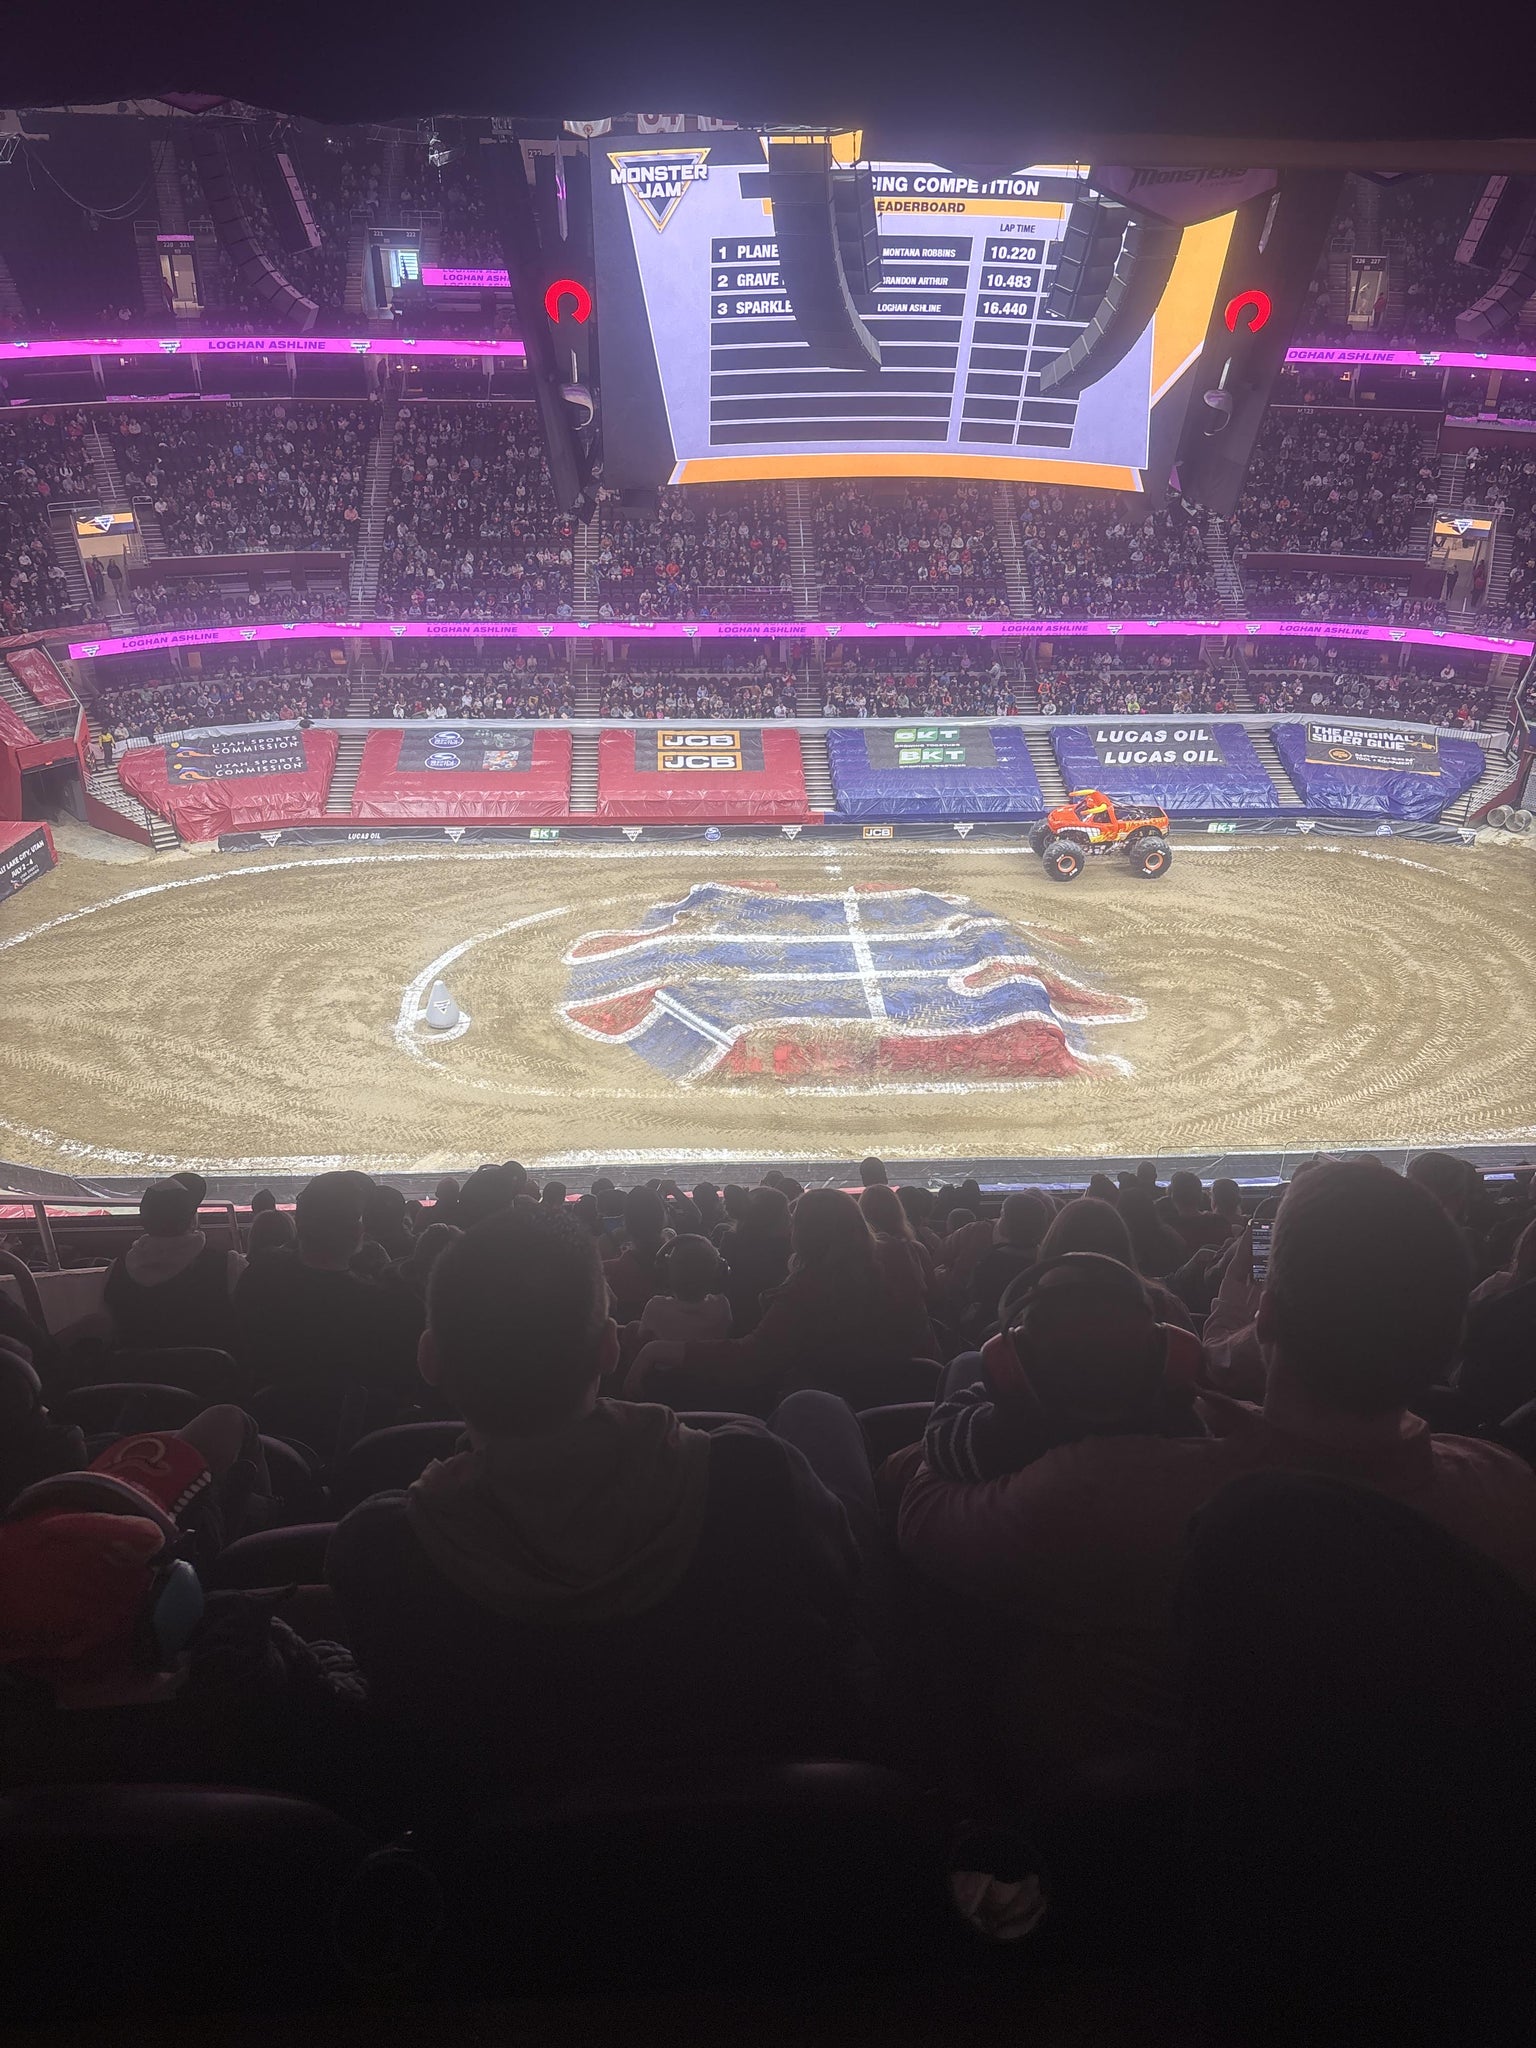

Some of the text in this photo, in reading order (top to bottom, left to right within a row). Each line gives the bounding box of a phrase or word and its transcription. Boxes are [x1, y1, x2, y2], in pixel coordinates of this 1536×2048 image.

[610, 164, 708, 184] MONSTER
[638, 182, 681, 199] JAM
[877, 201, 966, 213] EADERBOARD
[1000, 223, 1036, 233] LAP TIME
[718, 244, 780, 259] 1 PLANE
[882, 248, 956, 258] MONTANA ROBBINS
[991, 246, 1036, 260] 10.220
[717, 272, 780, 288] 2 GRAVE
[918, 277, 949, 286] ARTHUR
[986, 274, 1032, 289] 10.483
[717, 300, 794, 315] 3 SPARKLE
[877, 303, 942, 313] LOGHAN ASHLINE
[983, 302, 1028, 316] 16.440
[208, 340, 326, 350] LOGHAN ASHLINE
[1288, 350, 1395, 361] OGHAN ASHLINE
[1279, 625, 1370, 636] LOGHAN ASHLINE
[122, 632, 219, 649] LOGHAN ASHLINE
[664, 735, 734, 746] JCB
[896, 730, 958, 740] BKT
[1096, 730, 1168, 743] LUCAS
[1312, 725, 1414, 743] THE ORIGINAL
[211, 735, 298, 749] UTAH SPORTS
[212, 741, 298, 755] COMMISSION
[1311, 733, 1406, 751] SUPER GLUE
[664, 756, 736, 768] JCB
[900, 750, 964, 761] BKT
[1104, 750, 1177, 764] LUCAS
[215, 756, 302, 770] UTAH SPORTS
[216, 762, 302, 777] COMMISSION
[530, 829, 559, 839] BKT
[865, 828, 891, 837] JCB
